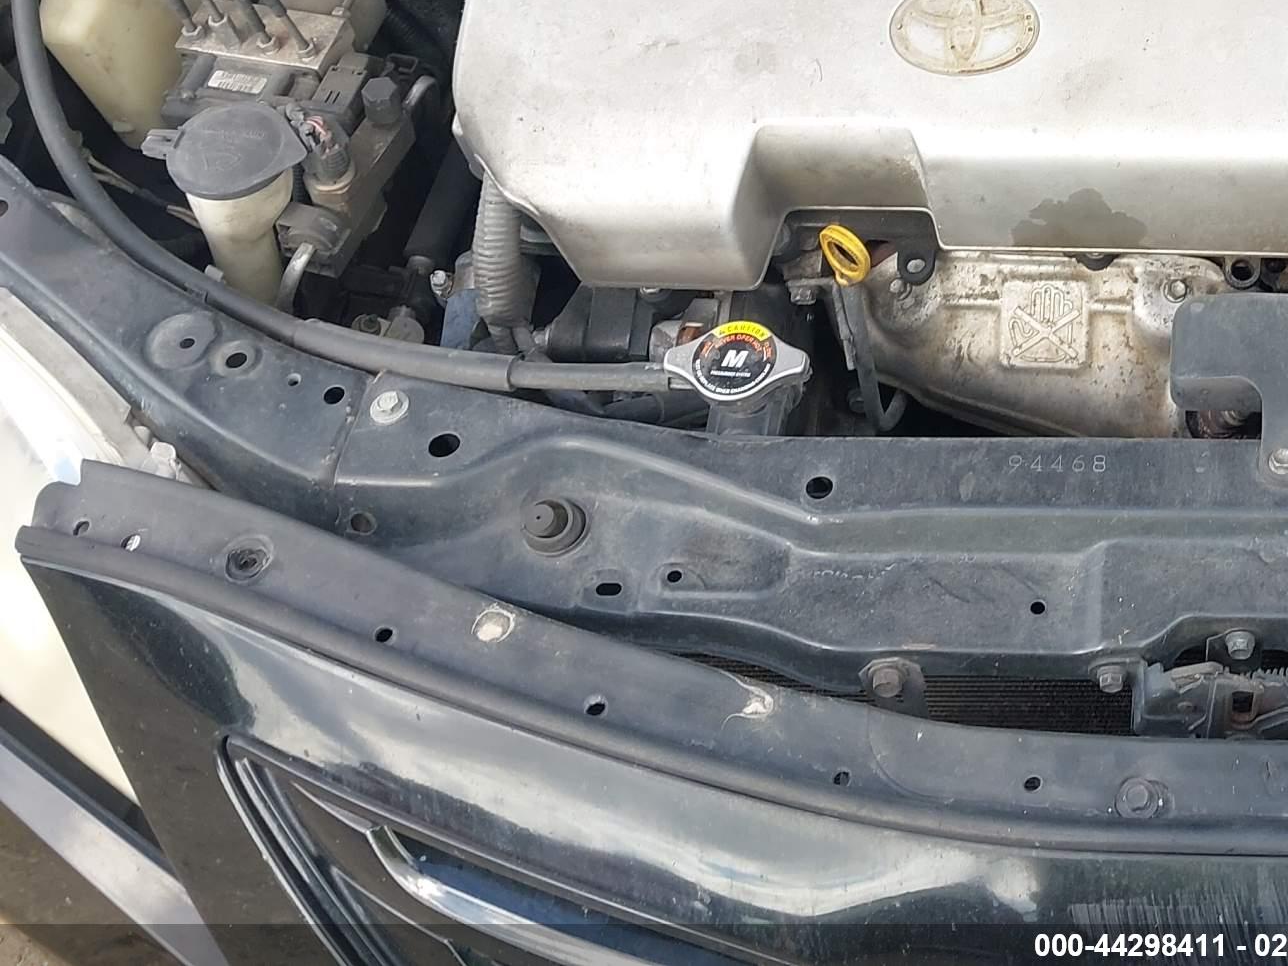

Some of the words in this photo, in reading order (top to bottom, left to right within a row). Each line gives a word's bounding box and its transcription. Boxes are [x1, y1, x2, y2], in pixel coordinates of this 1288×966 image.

[727, 325, 766, 338] CAUTION
[721, 349, 749, 368] M
[1008, 454, 1106, 474] 94468
